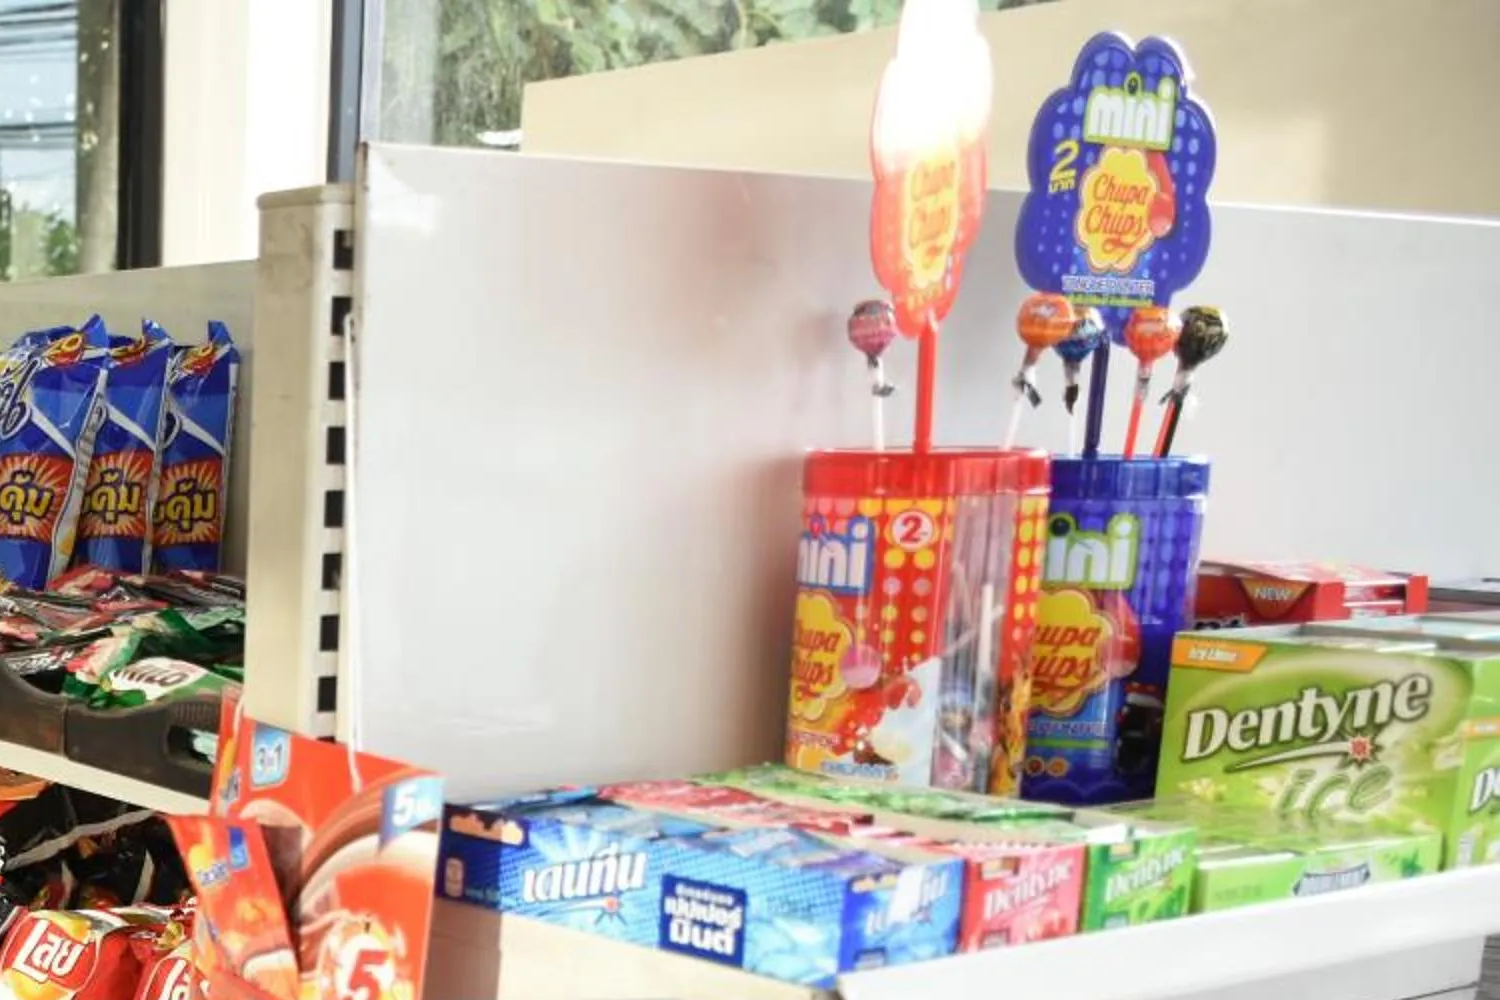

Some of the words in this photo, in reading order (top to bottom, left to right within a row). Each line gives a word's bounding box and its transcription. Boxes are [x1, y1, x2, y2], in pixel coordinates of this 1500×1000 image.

[1090, 77, 1174, 145] mini
[1052, 140, 1078, 180] 2
[1092, 173, 1148, 207] Chupa
[1086, 203, 1144, 238] Chups
[1046, 514, 1133, 584] ini
[1254, 586, 1292, 603] NEW
[1031, 624, 1102, 653] upa
[1028, 654, 1093, 684] ups
[1181, 672, 1432, 764] Dentyne
